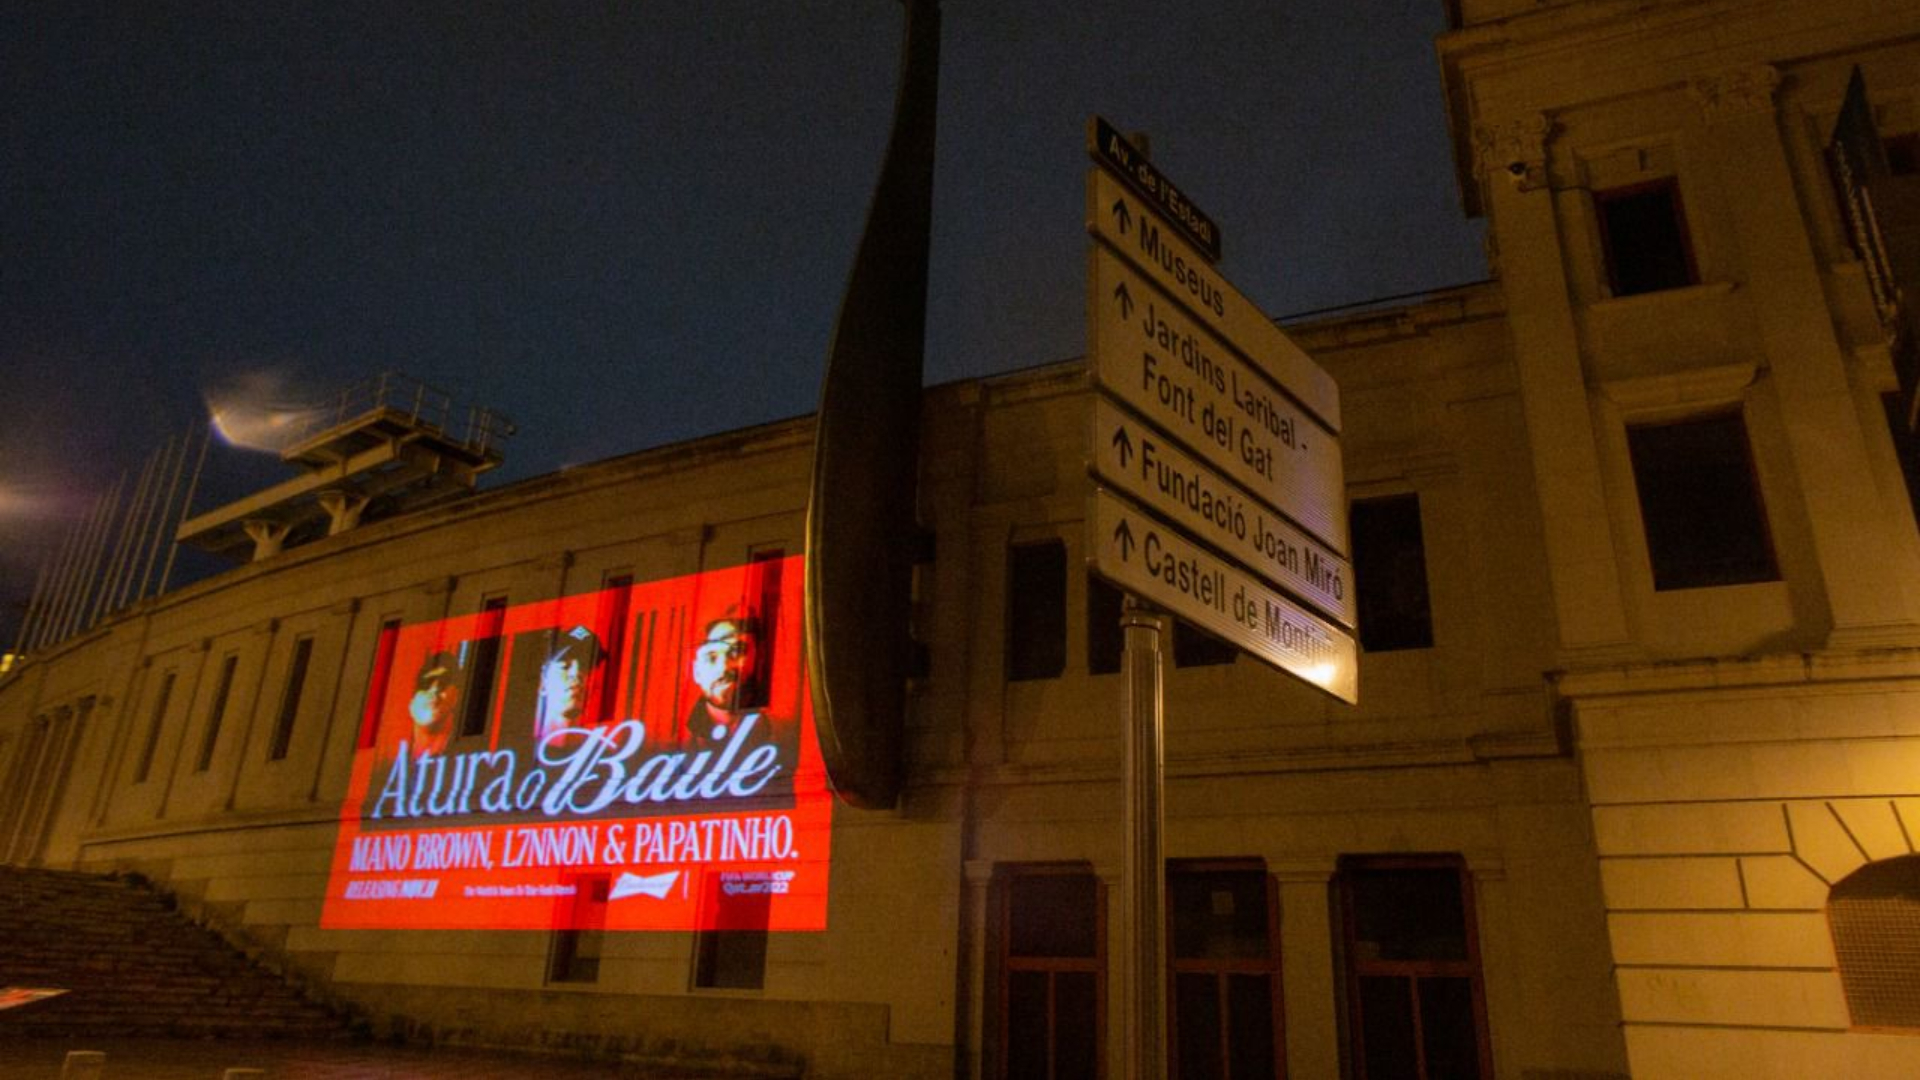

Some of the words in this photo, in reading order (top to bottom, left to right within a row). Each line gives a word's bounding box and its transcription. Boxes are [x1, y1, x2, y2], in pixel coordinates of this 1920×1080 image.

[1109, 135, 1134, 171] Av.
[1138, 163, 1157, 192] de
[1160, 179, 1212, 245] l'Estadi
[1139, 214, 1225, 318] Museus
[1143, 304, 1226, 395] Jardins
[1231, 369, 1296, 450] Laribal
[1143, 352, 1196, 424] Font
[1202, 403, 1234, 452] del
[1240, 428, 1273, 482] Gat
[1142, 439, 1247, 541] Fundació
[1253, 516, 1299, 575] Joan
[1304, 547, 1344, 602] Miró
[1144, 532, 1226, 614] Castell
[1233, 585, 1258, 630] de
[369, 740, 516, 819] Atura
[516, 768, 547, 811] o
[537, 713, 782, 816] Baile
[349, 833, 411, 872] MANO
[413, 830, 495, 871] BROWN,
[501, 825, 598, 868] L7NNON
[603, 823, 627, 865] &
[633, 814, 800, 864] PAPATINHO.
